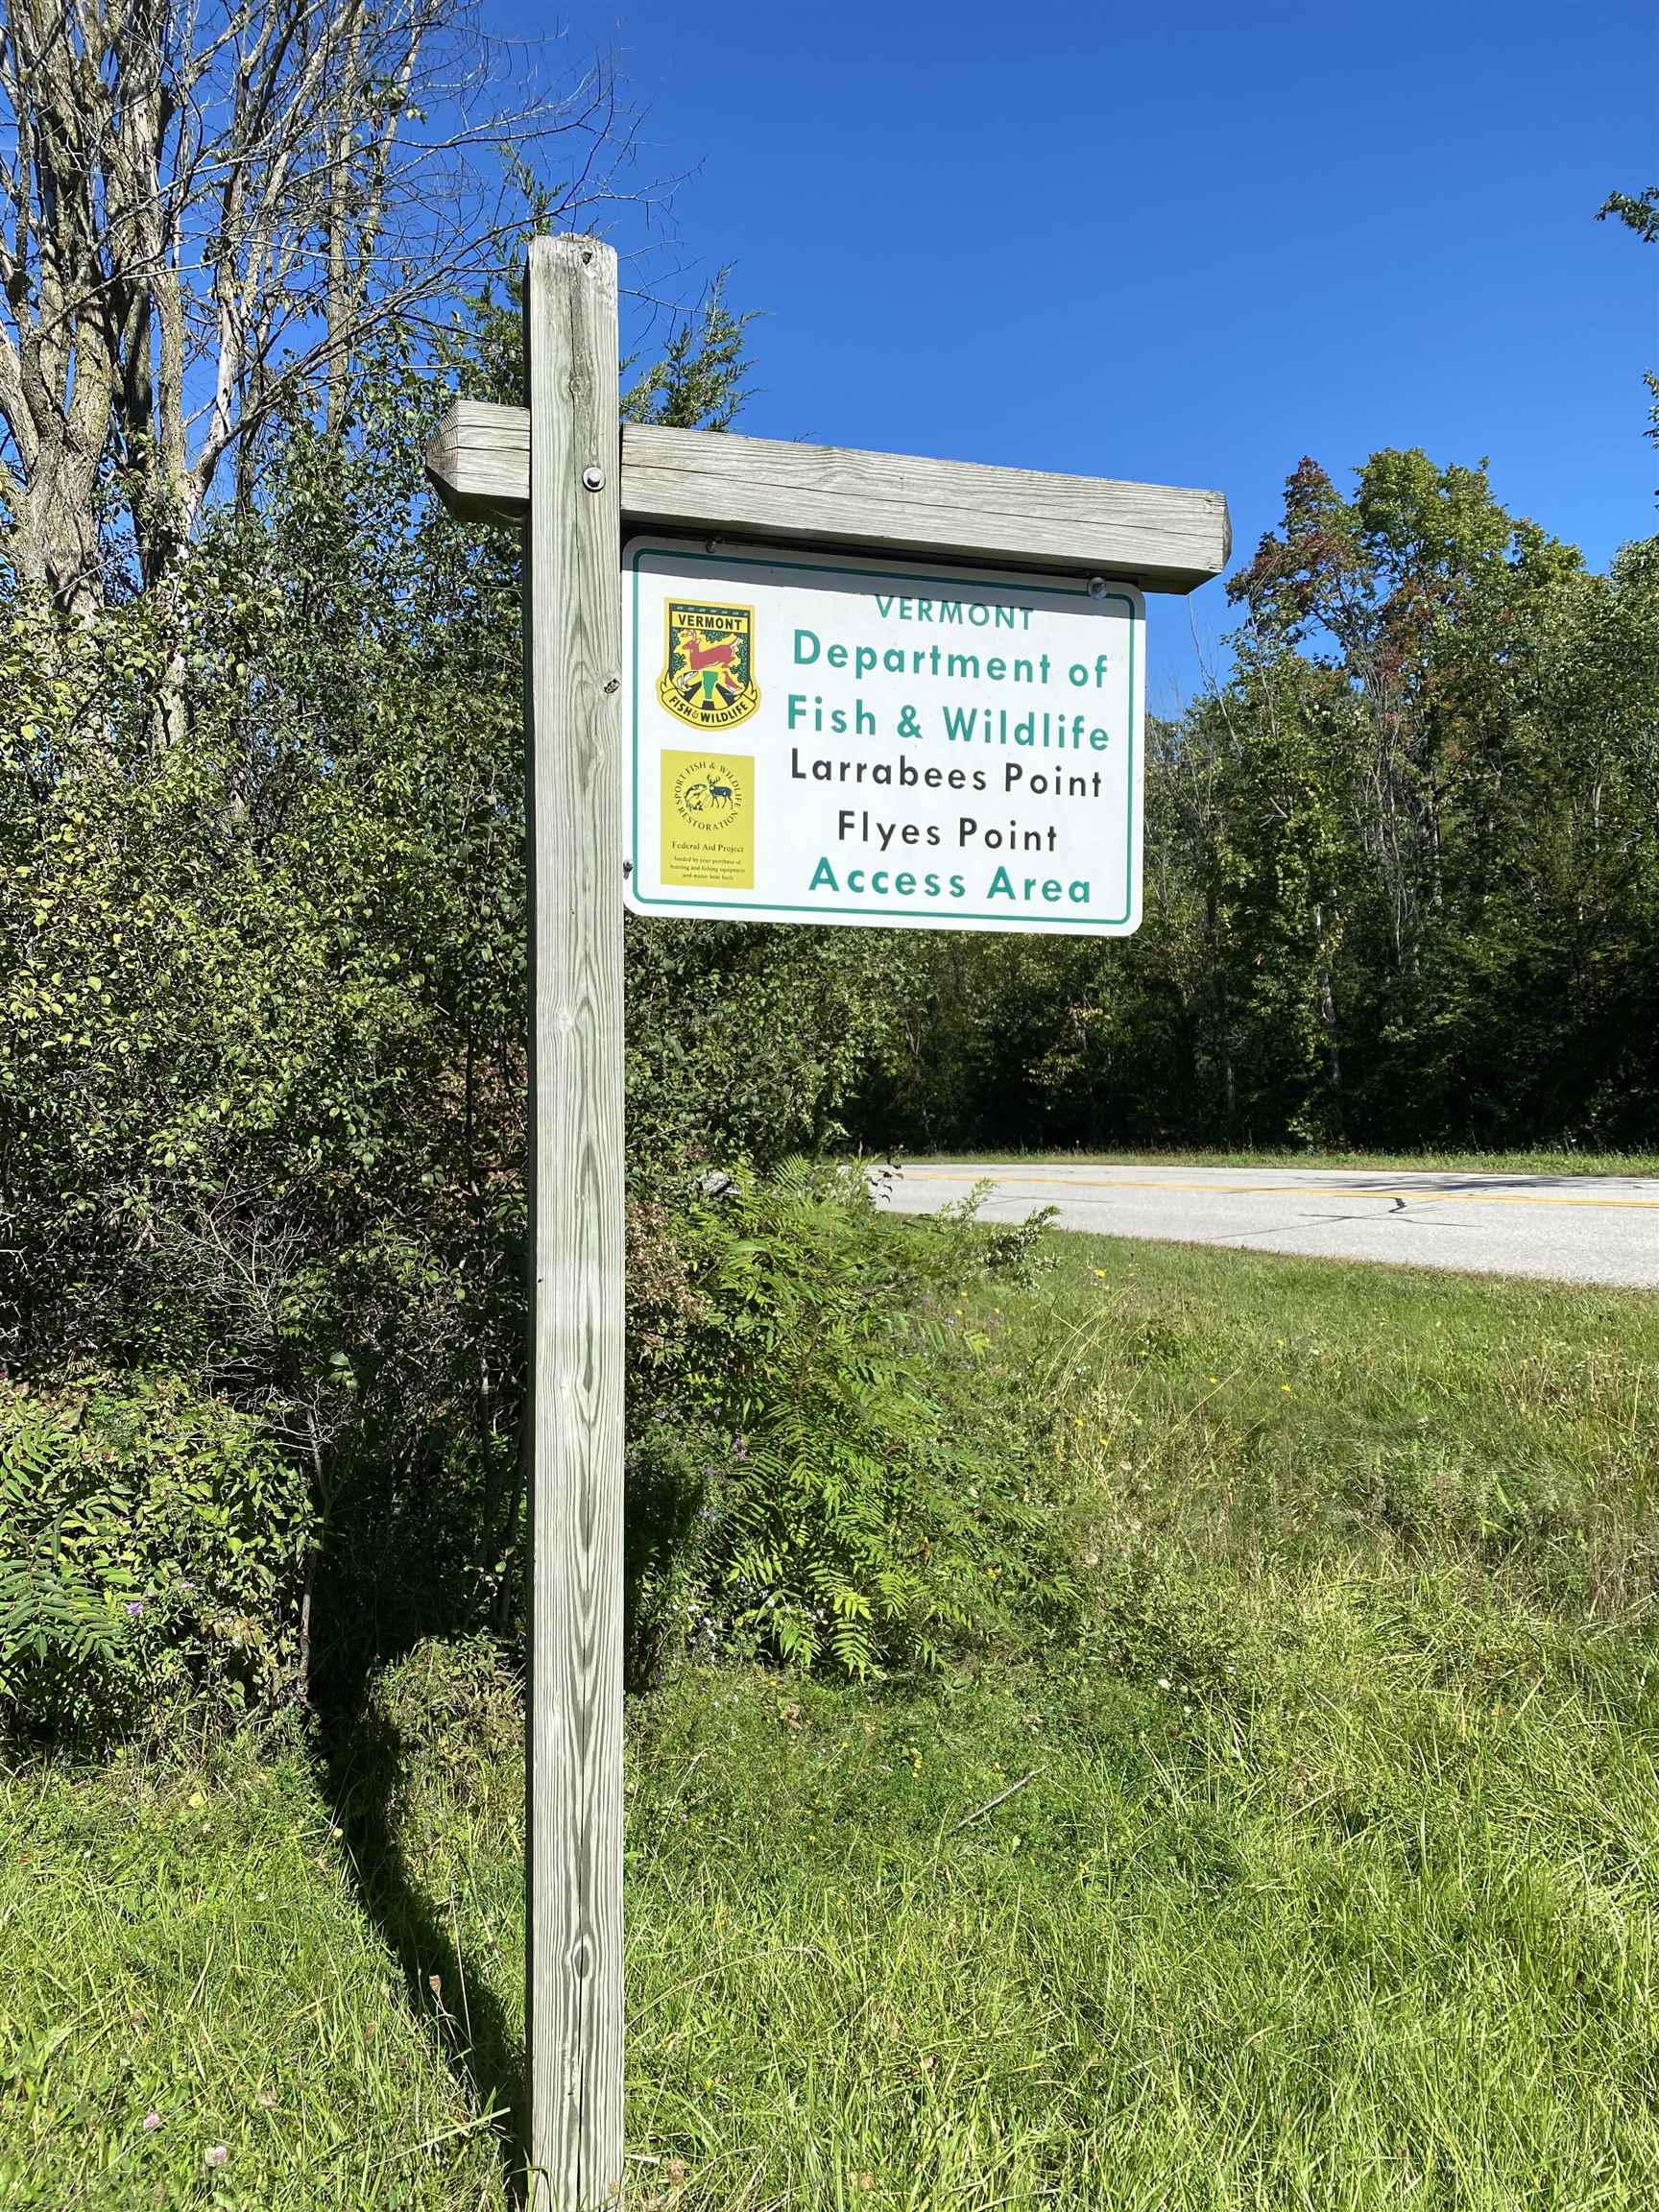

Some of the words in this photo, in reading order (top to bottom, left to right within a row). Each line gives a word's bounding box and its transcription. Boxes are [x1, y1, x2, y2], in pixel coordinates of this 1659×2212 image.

[678, 614, 742, 630] VERMONT
[875, 594, 1034, 630] VERMONT
[794, 629, 1050, 684] Department
[1070, 655, 1107, 687] of
[668, 695, 691, 717] FISH
[700, 701, 749, 723] WILDLIFE
[788, 694, 876, 734] Fish
[898, 706, 922, 737] &
[943, 707, 1108, 751] Wildlife
[685, 760, 707, 774] FISH
[792, 748, 986, 790] Larrabees
[1006, 763, 1101, 797] Point
[672, 840, 700, 851] Federal
[839, 810, 940, 851] Flyes
[960, 818, 1056, 852] Point
[809, 857, 965, 898] Access
[987, 866, 1090, 902] Area
